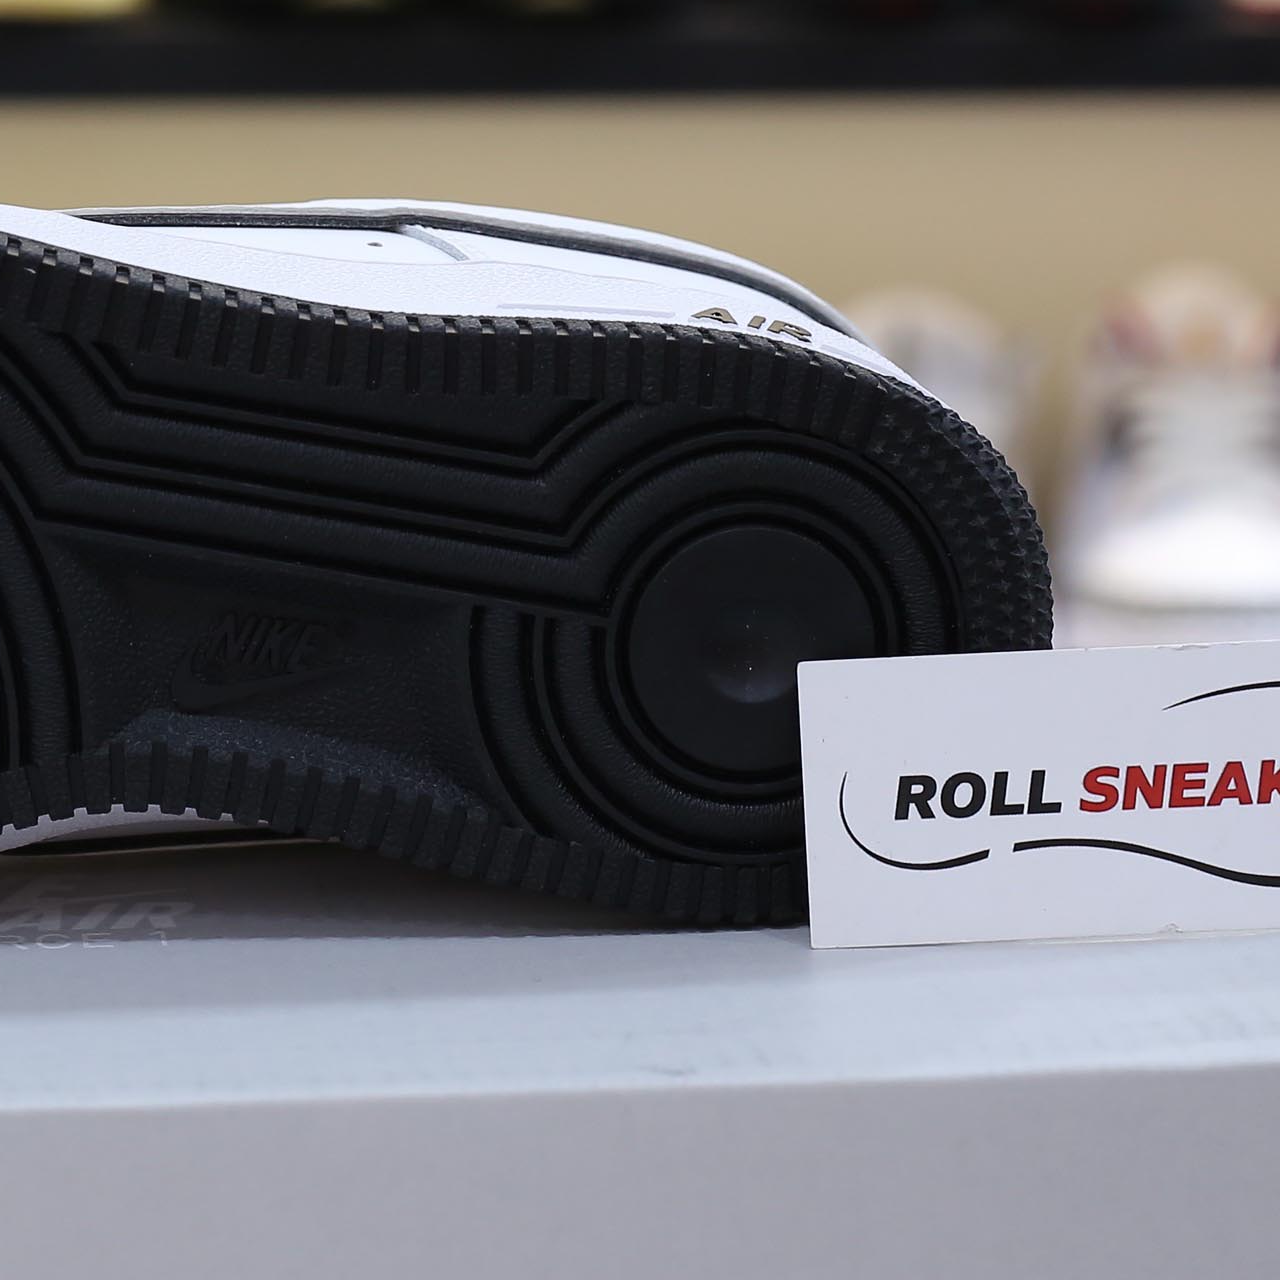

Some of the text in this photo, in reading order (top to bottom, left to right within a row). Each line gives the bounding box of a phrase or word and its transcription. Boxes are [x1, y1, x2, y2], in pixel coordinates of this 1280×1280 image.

[691, 307, 812, 343] AIR
[894, 770, 1062, 821] ROLL
[148, 931, 168, 946] 1
